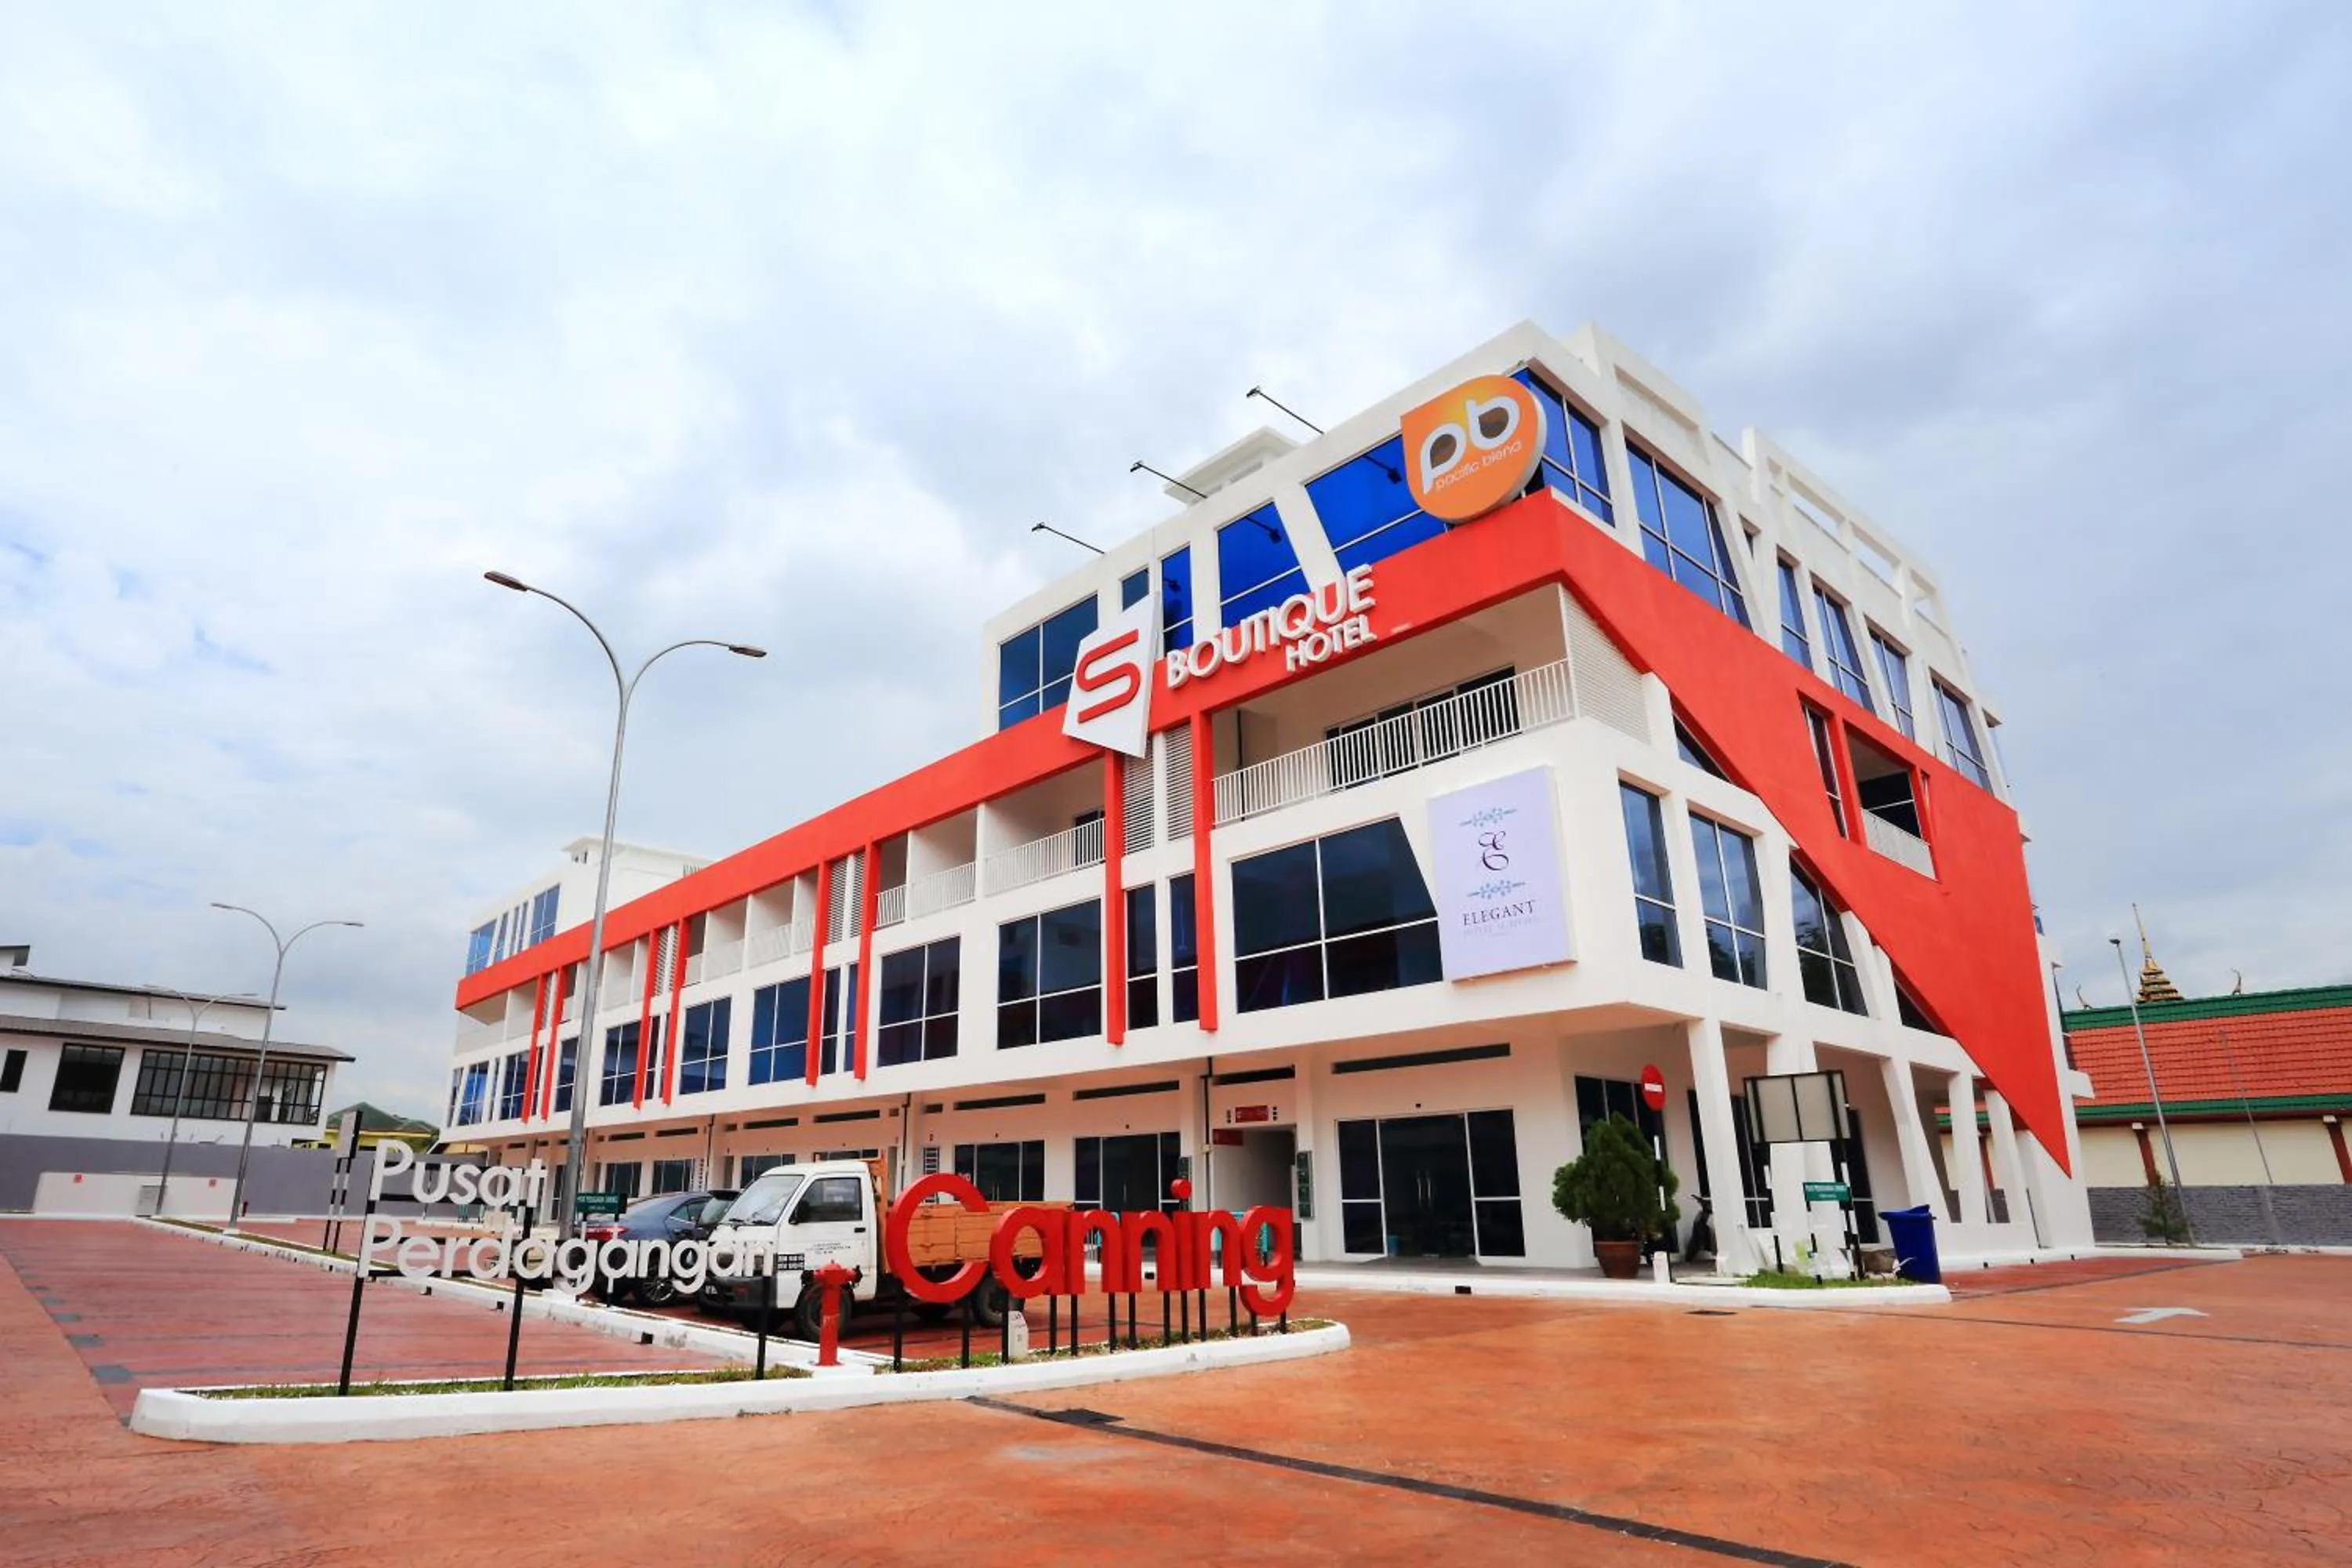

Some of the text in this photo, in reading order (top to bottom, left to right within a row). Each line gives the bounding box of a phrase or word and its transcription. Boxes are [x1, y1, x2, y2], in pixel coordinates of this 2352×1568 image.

[1421, 396, 1520, 495] pb
[1436, 441, 1521, 490] pacific blend
[1076, 564, 1376, 724] S BOUTIQUE
[1285, 614, 1377, 672] HOTEL
[1463, 899, 1537, 926] ELEGANT
[370, 1139, 548, 1206] Pusat
[358, 1215, 777, 1294] Perdagangan
[887, 1173, 1295, 1315] Canning
